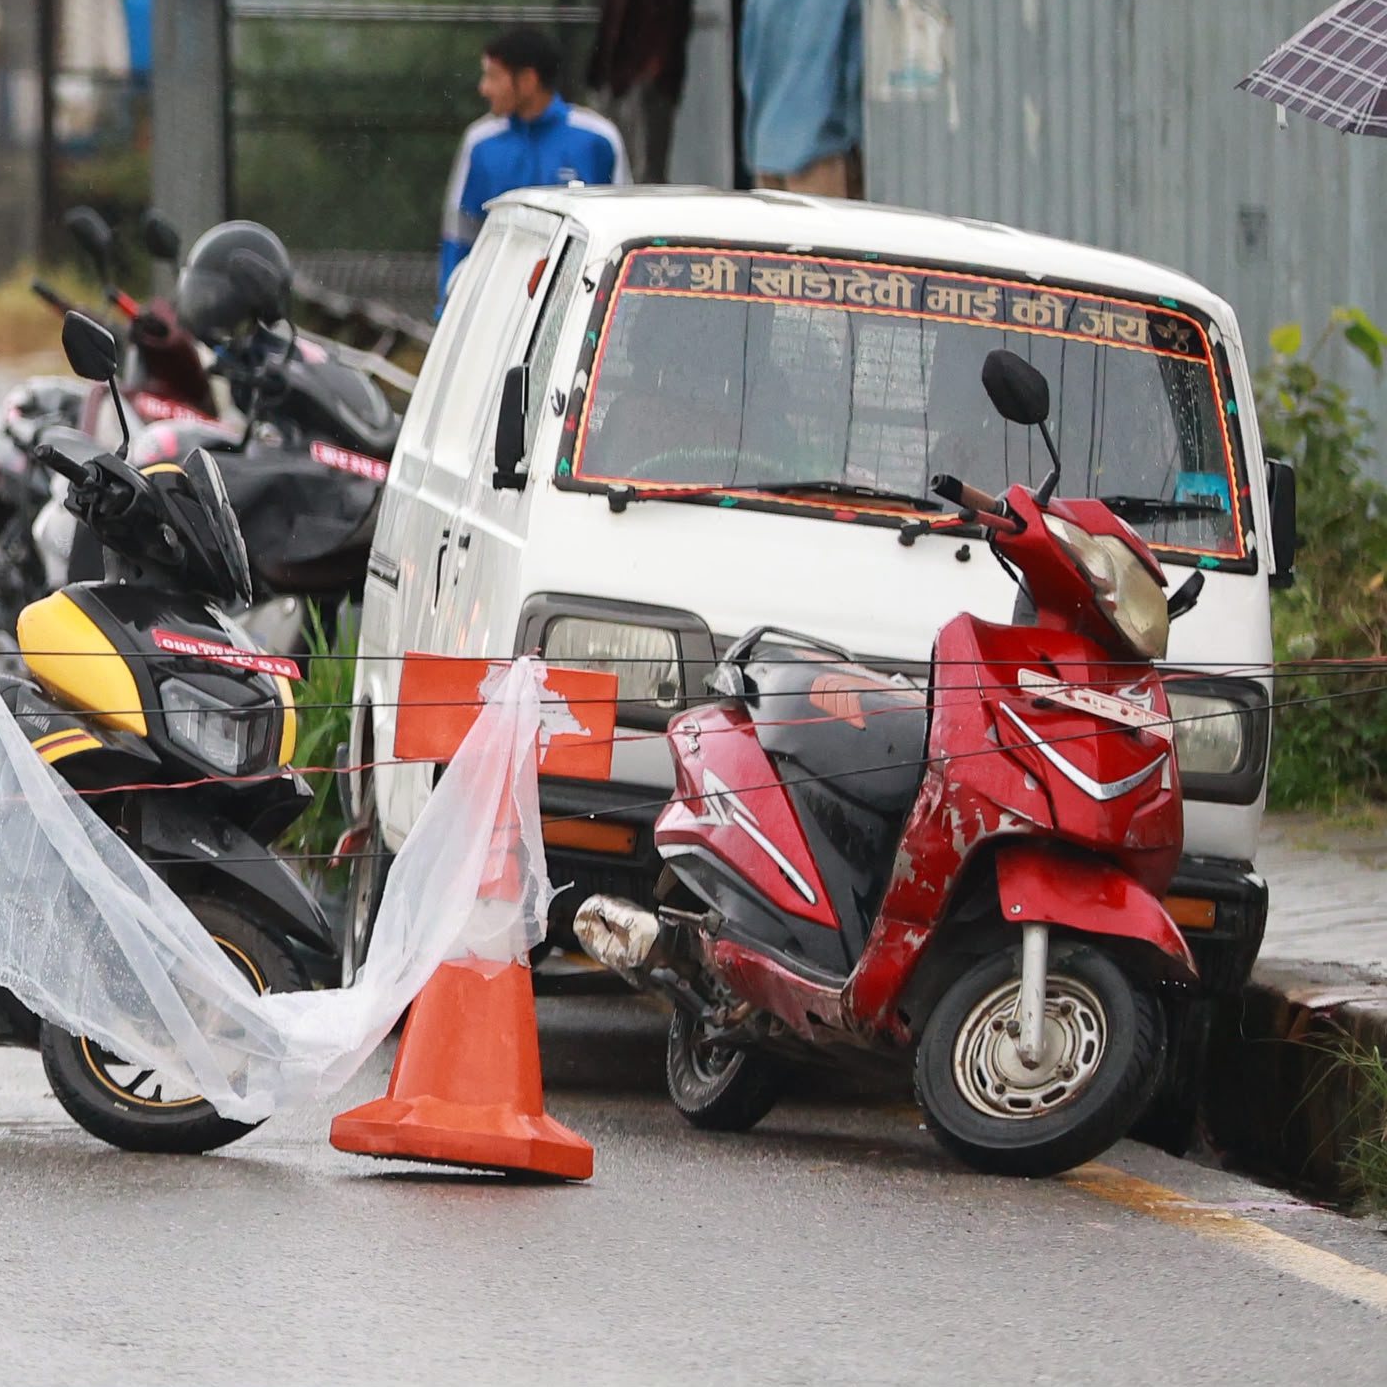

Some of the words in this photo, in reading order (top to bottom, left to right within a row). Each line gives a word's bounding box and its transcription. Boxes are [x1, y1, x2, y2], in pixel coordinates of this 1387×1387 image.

[690, 256, 739, 292] श्री
[925, 284, 1001, 321] माई
[1012, 295, 1068, 329] की
[1078, 306, 1152, 345] जय
